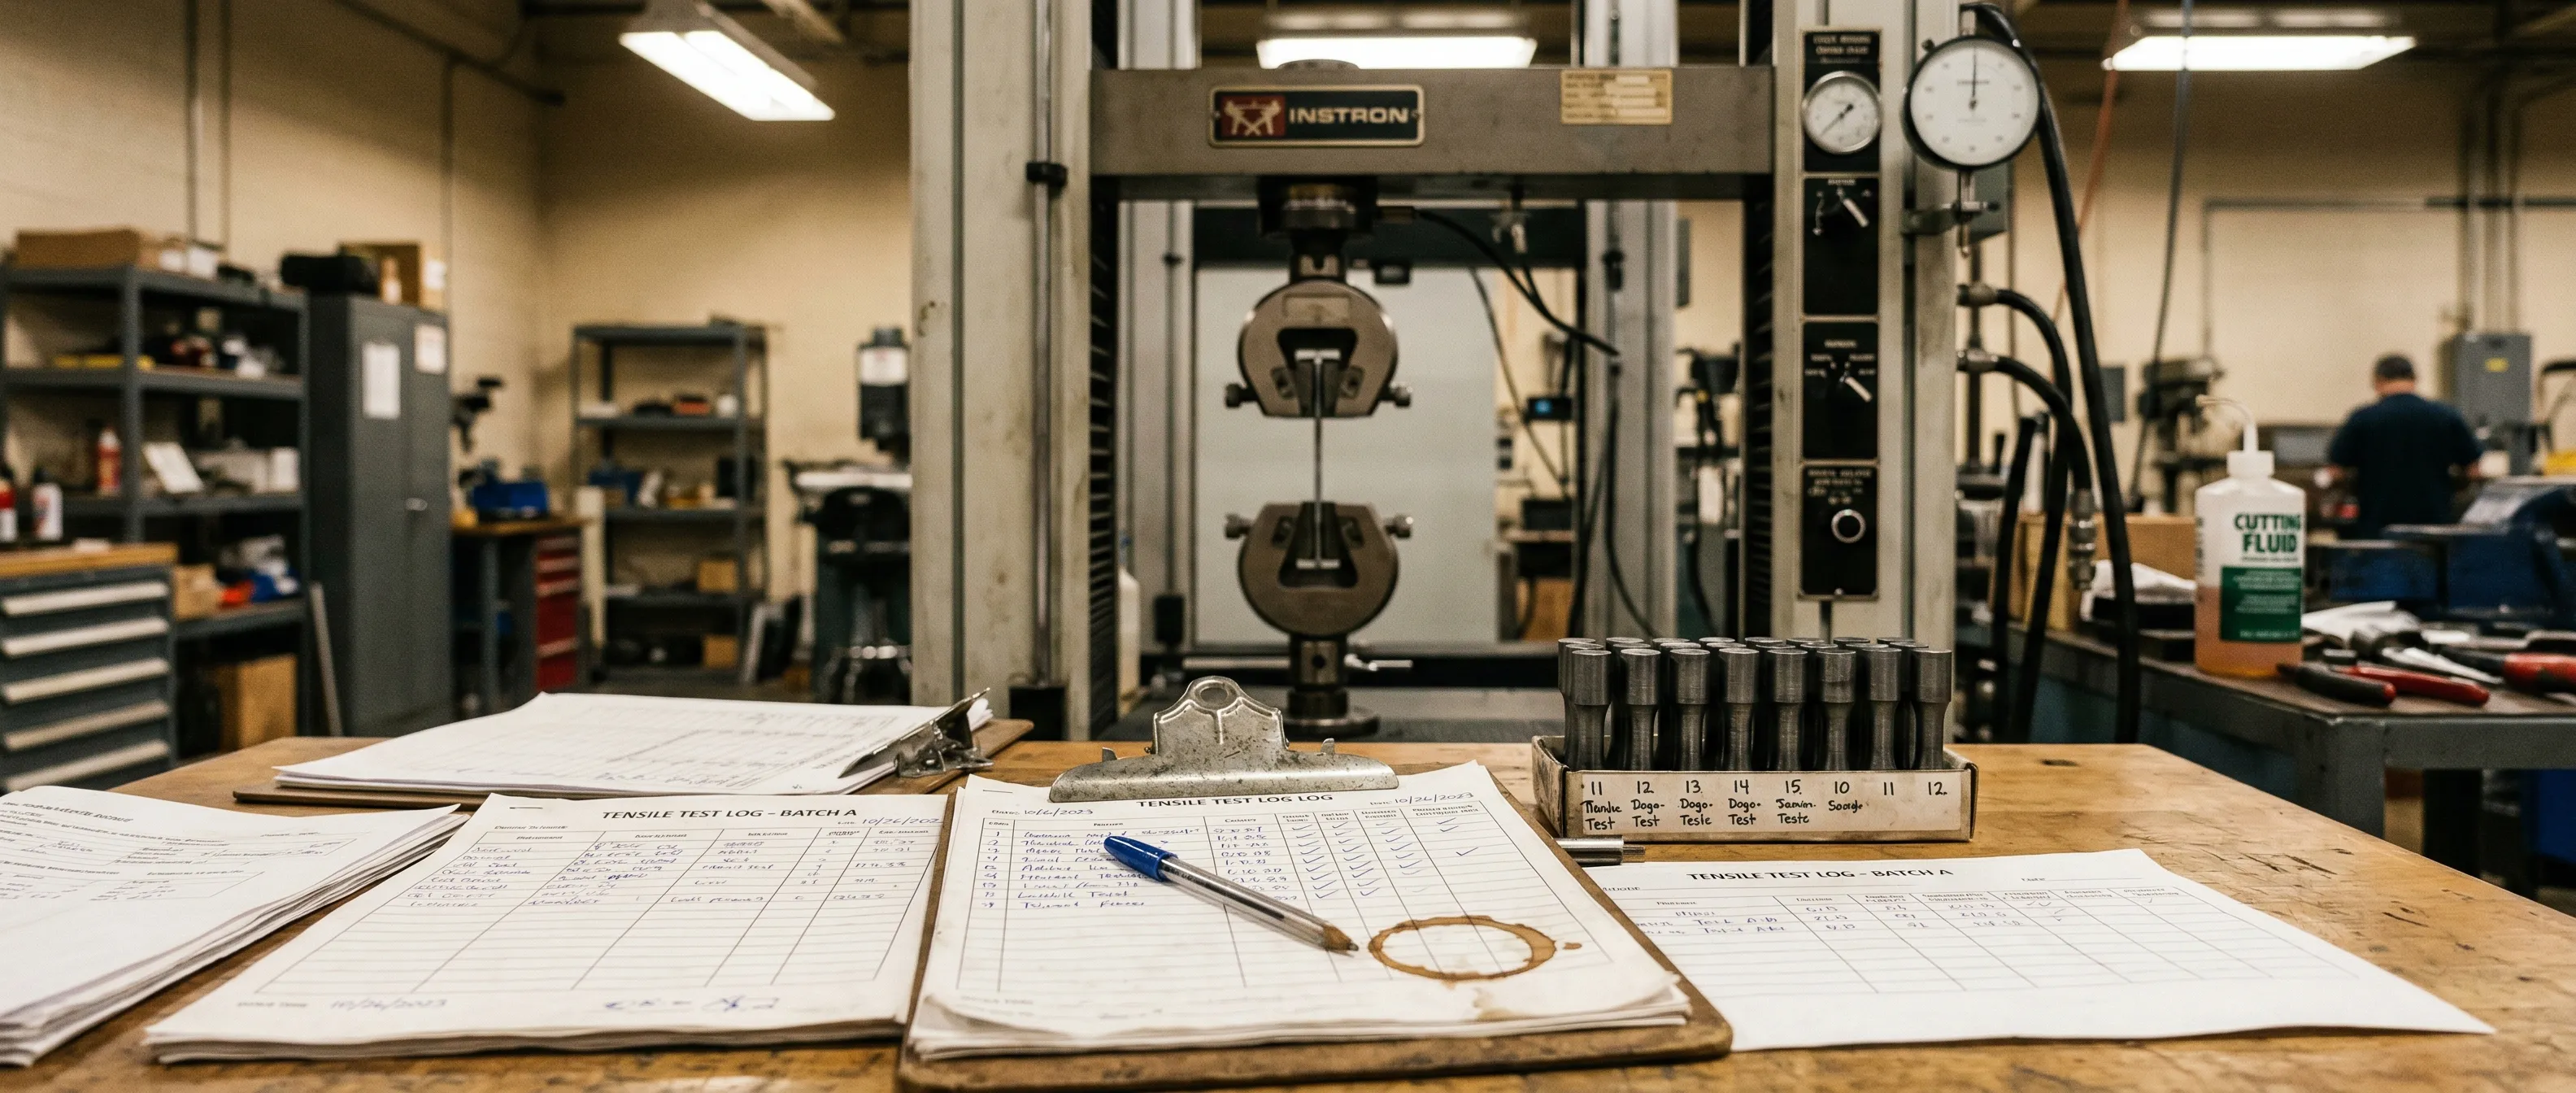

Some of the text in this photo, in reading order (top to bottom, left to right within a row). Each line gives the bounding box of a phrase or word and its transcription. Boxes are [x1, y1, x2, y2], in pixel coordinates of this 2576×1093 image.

[1288, 107, 1408, 124] INSTRON
[2243, 534, 2297, 552] FLUID
[1591, 781, 1603, 795] 11
[1734, 779, 1749, 795] 14
[1834, 781, 1850, 794] 10
[1883, 782, 1895, 795] 11
[1136, 798, 1207, 808] TENSILE
[603, 811, 674, 820] TENSILE
[680, 810, 722, 818] TEST
[781, 809, 840, 817] BATCH
[1632, 815, 1660, 827] Test
[1728, 813, 1756, 825] Test
[1585, 816, 1616, 830] Test
[1870, 869, 1934, 877] BATCH
